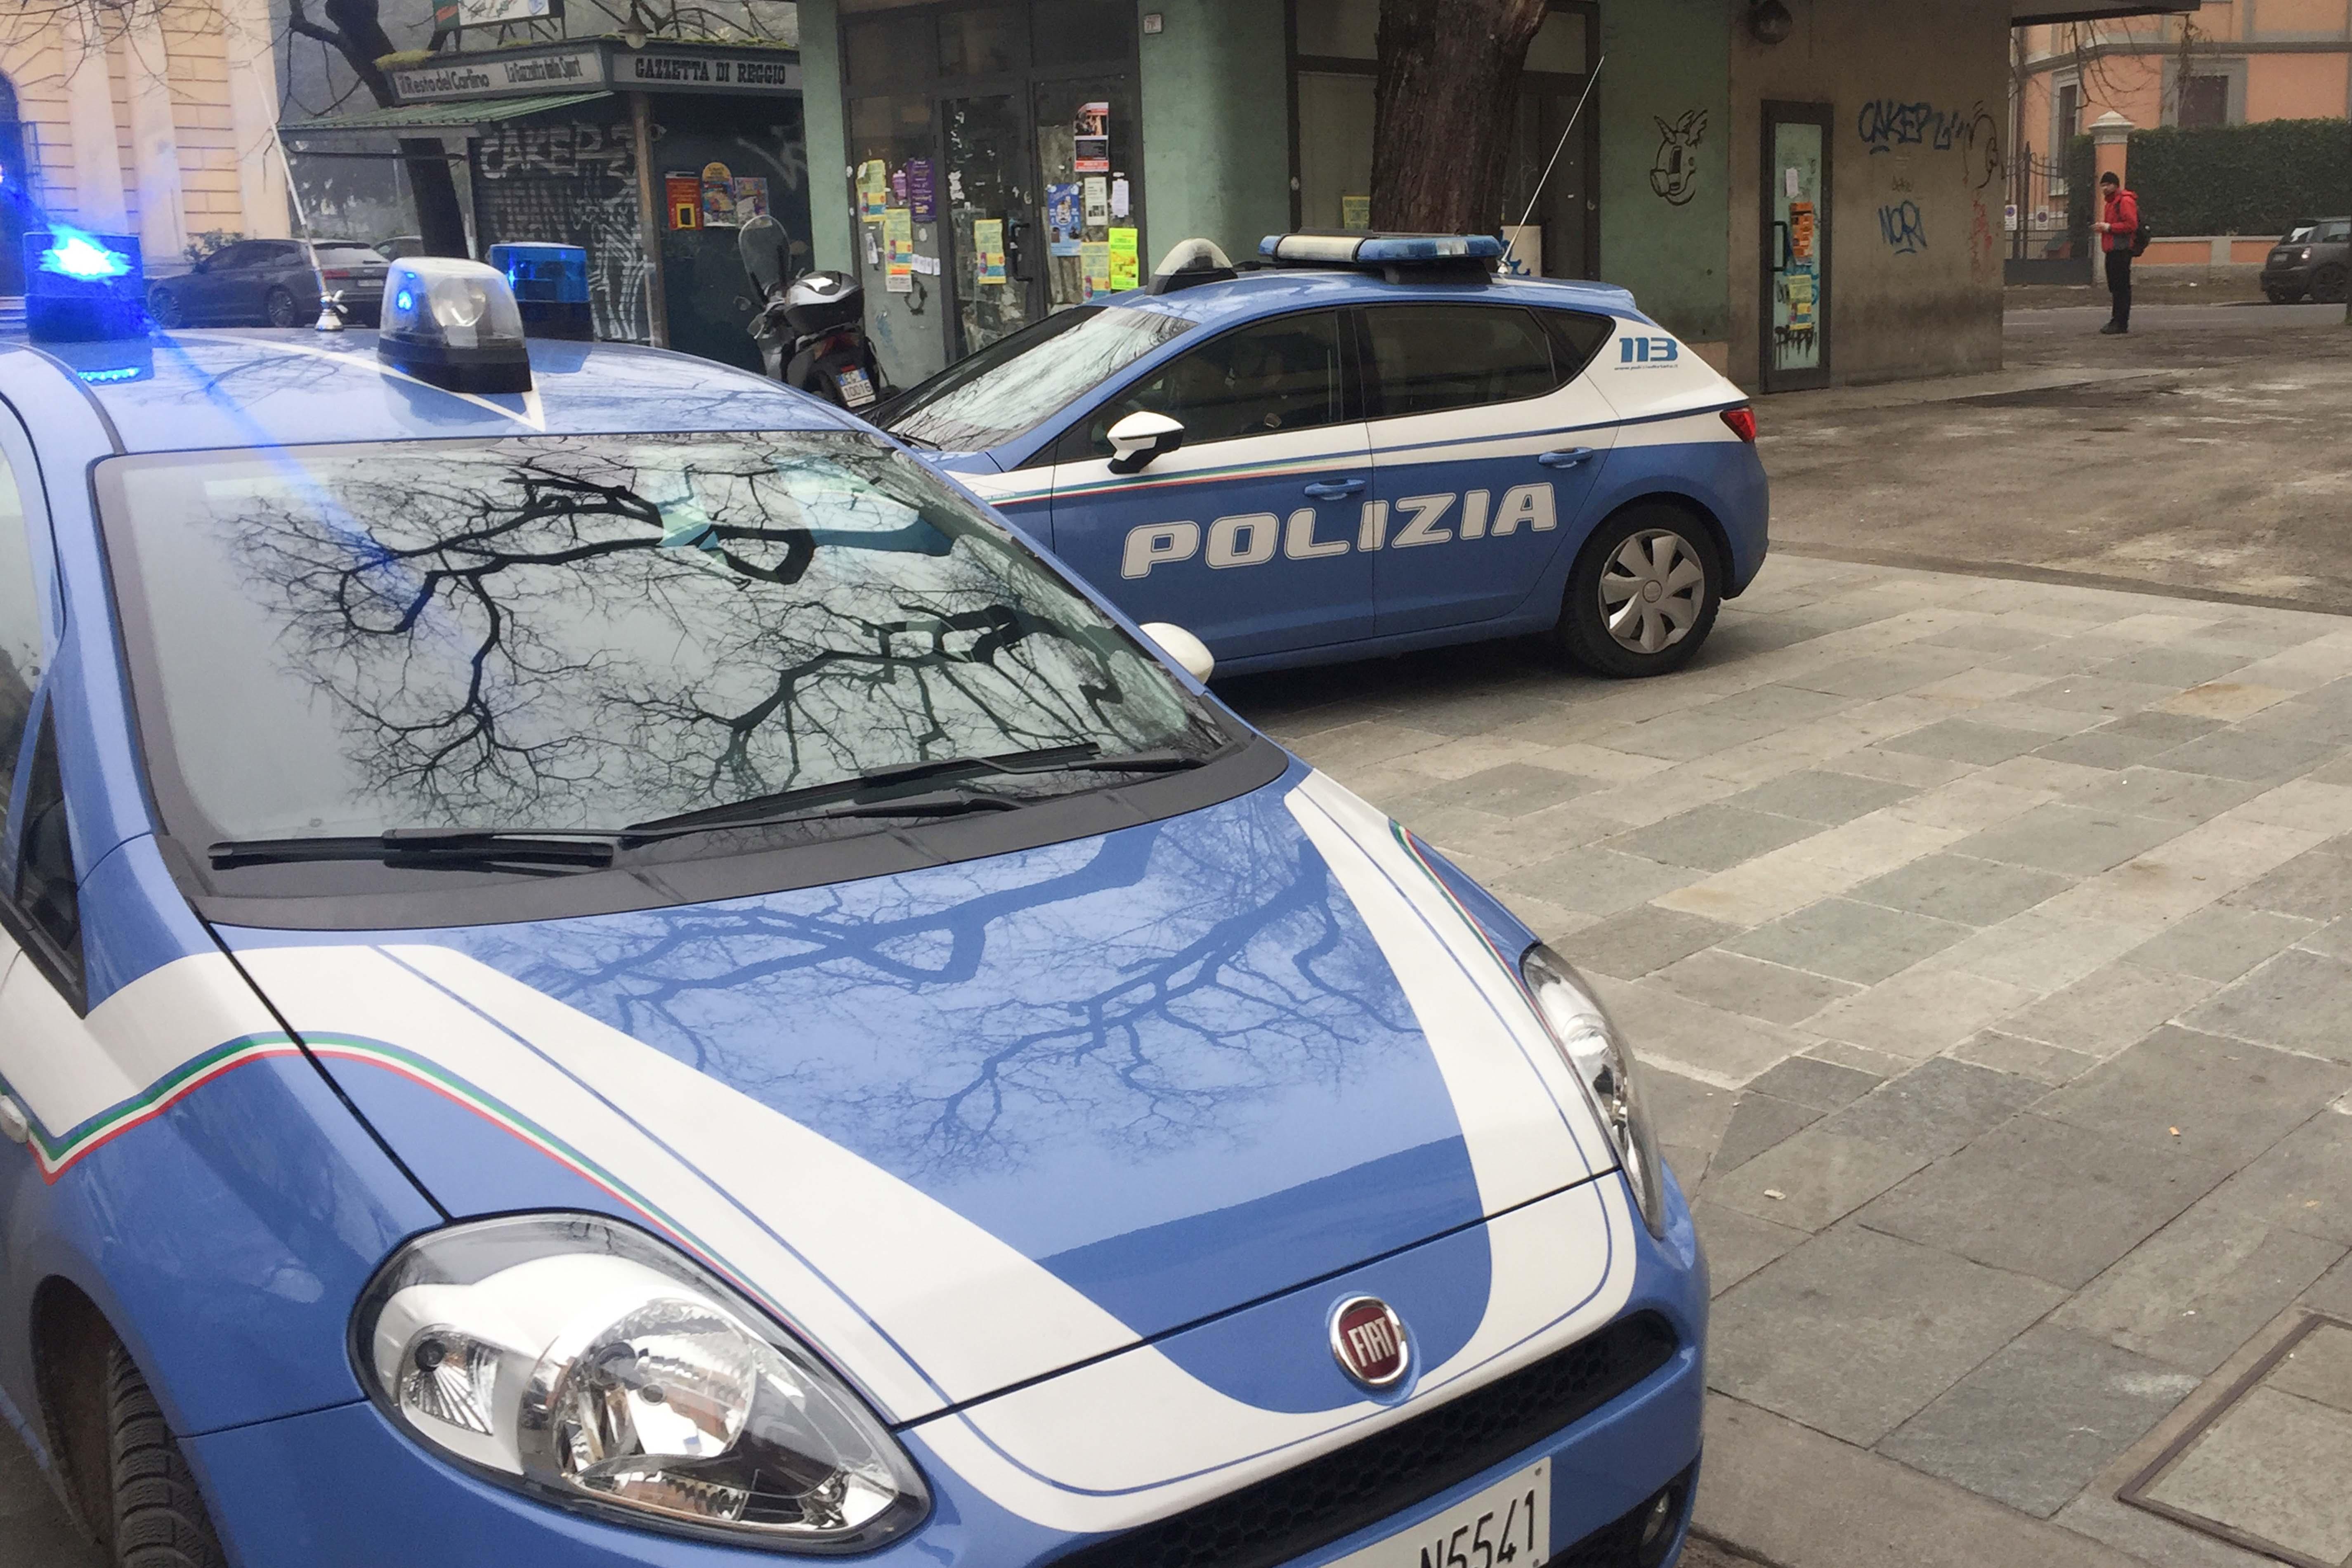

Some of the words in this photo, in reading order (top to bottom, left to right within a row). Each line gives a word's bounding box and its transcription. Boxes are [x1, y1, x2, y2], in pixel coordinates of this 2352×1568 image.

[635, 58, 710, 81] GAZZETTA
[716, 62, 730, 82] DI
[737, 63, 786, 84] REGGIO
[1619, 337, 1678, 363] 113
[1121, 482, 1557, 580] POLIZIA
[1348, 1316, 1396, 1367] FIAT
